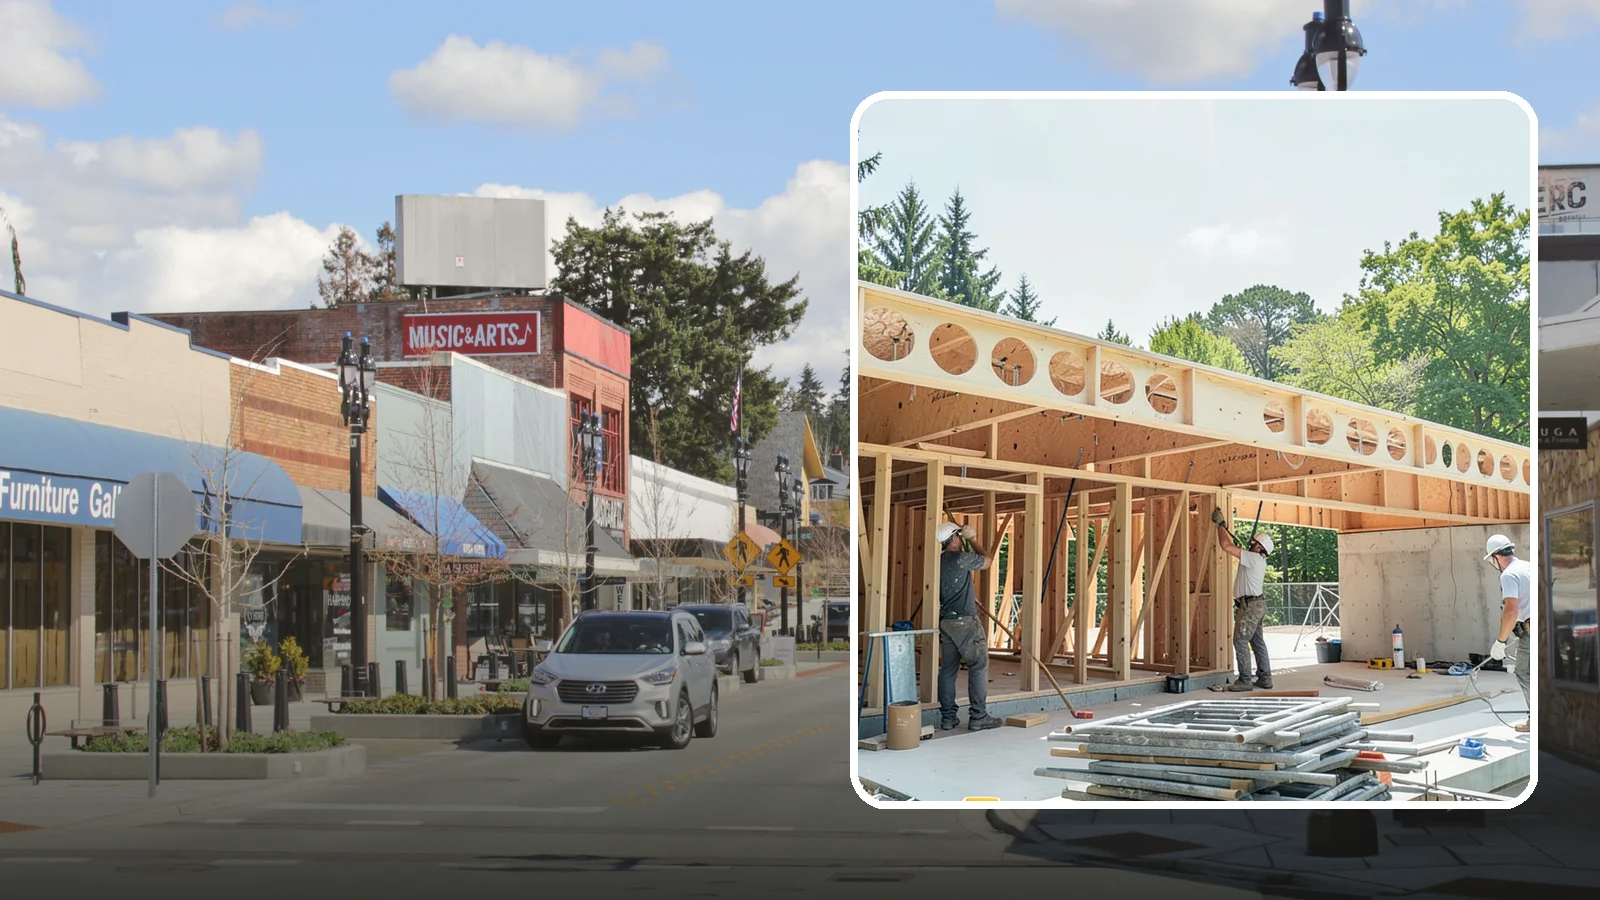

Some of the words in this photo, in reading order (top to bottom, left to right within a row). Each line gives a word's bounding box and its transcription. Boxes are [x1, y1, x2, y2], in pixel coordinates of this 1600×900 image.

[409, 323, 519, 348] MUSIC&ARTS
[0, 471, 79, 515] Furniture
[453, 563, 480, 574] SUSHI
